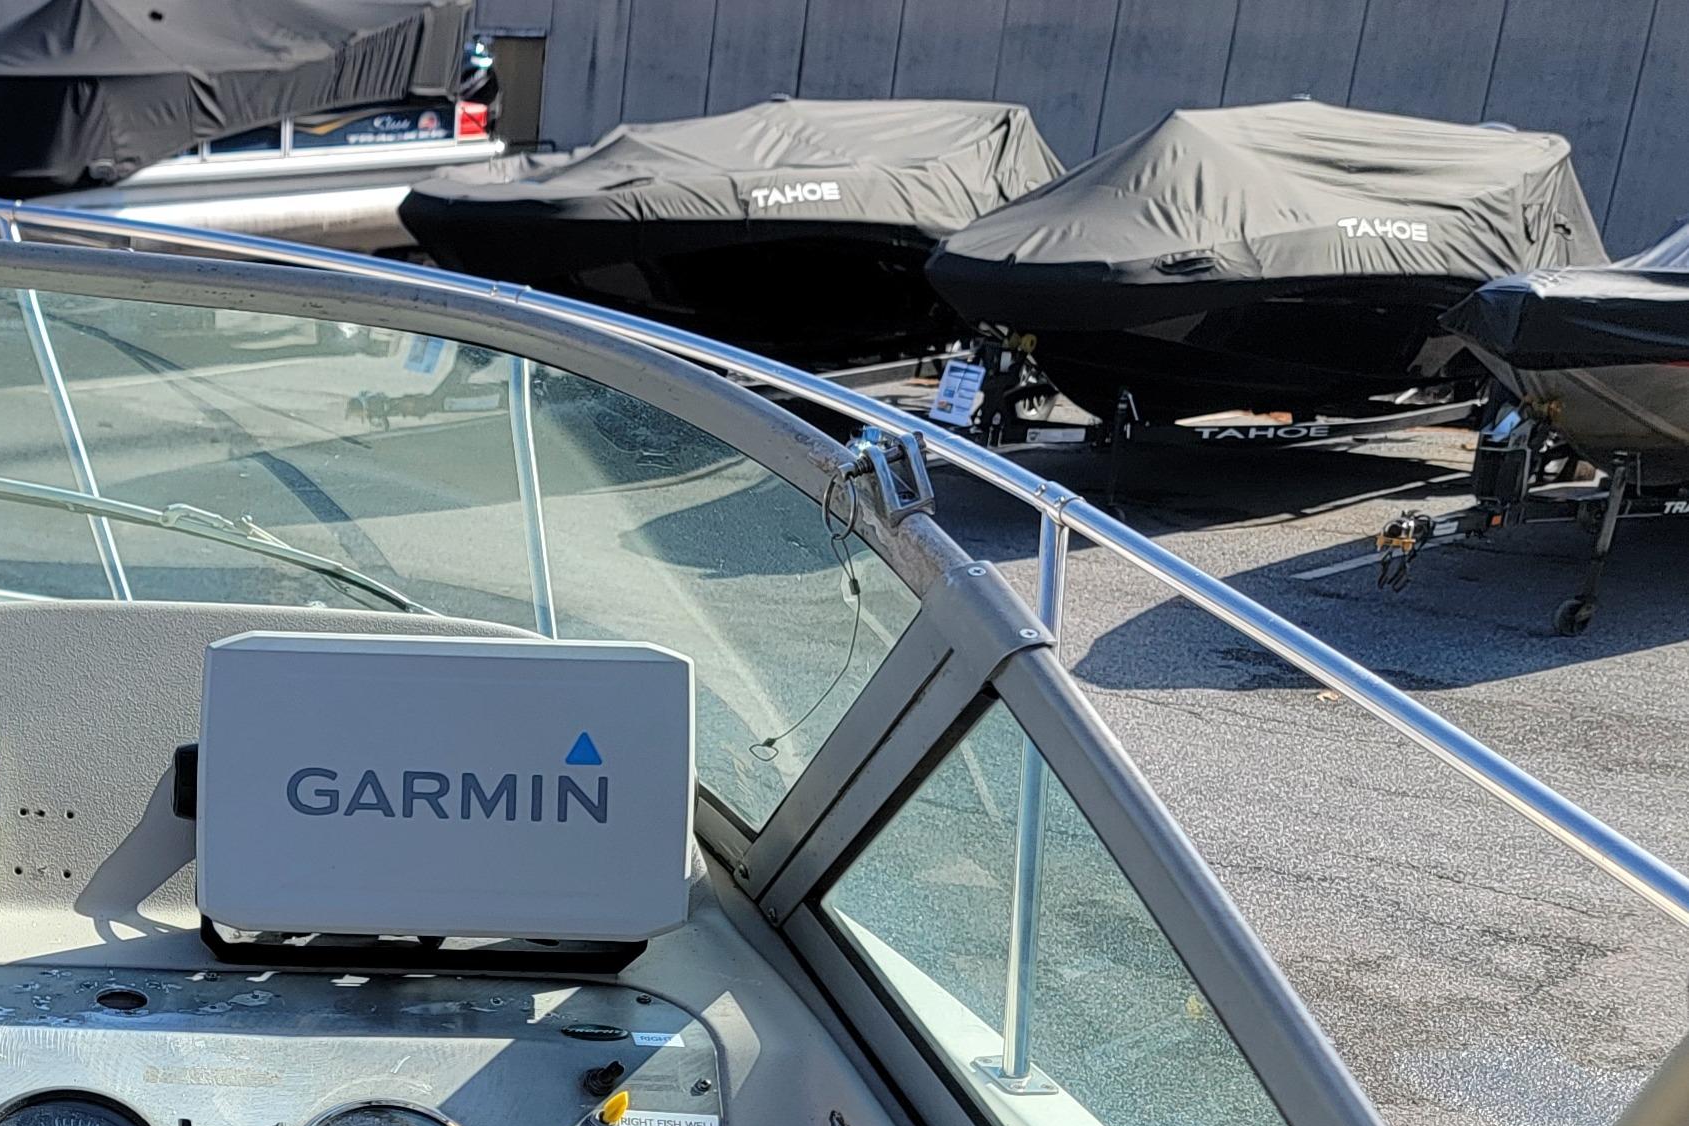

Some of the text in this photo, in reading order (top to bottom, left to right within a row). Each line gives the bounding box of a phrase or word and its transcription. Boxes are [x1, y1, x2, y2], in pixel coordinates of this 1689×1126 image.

[751, 182, 841, 208] TAHOE
[1337, 218, 1429, 242] TAHOE
[1195, 426, 1330, 439] TAHOE
[286, 767, 609, 824] GARMIN
